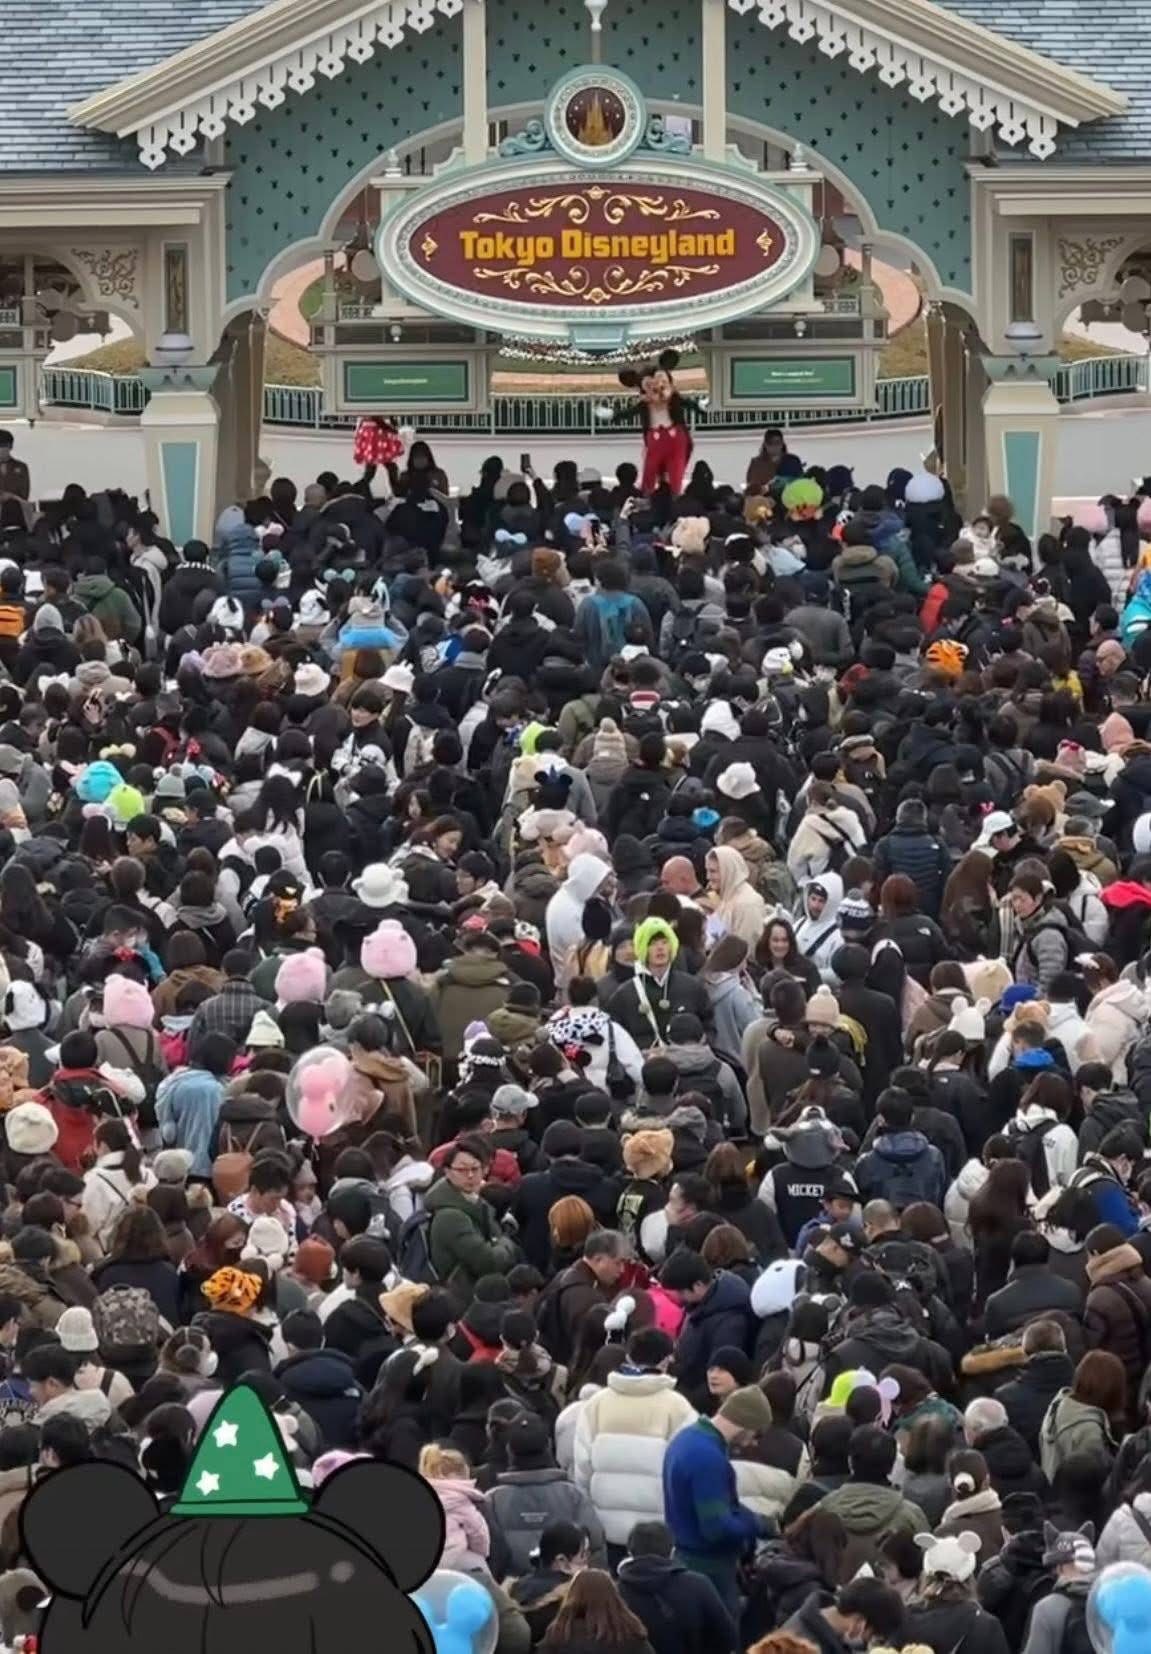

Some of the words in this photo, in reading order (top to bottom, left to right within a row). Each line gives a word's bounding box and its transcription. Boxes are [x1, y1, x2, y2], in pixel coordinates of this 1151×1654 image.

[459, 230, 553, 265] Tokyo
[561, 228, 734, 264] Disneyland
[787, 1183, 824, 1197] MICKEY
